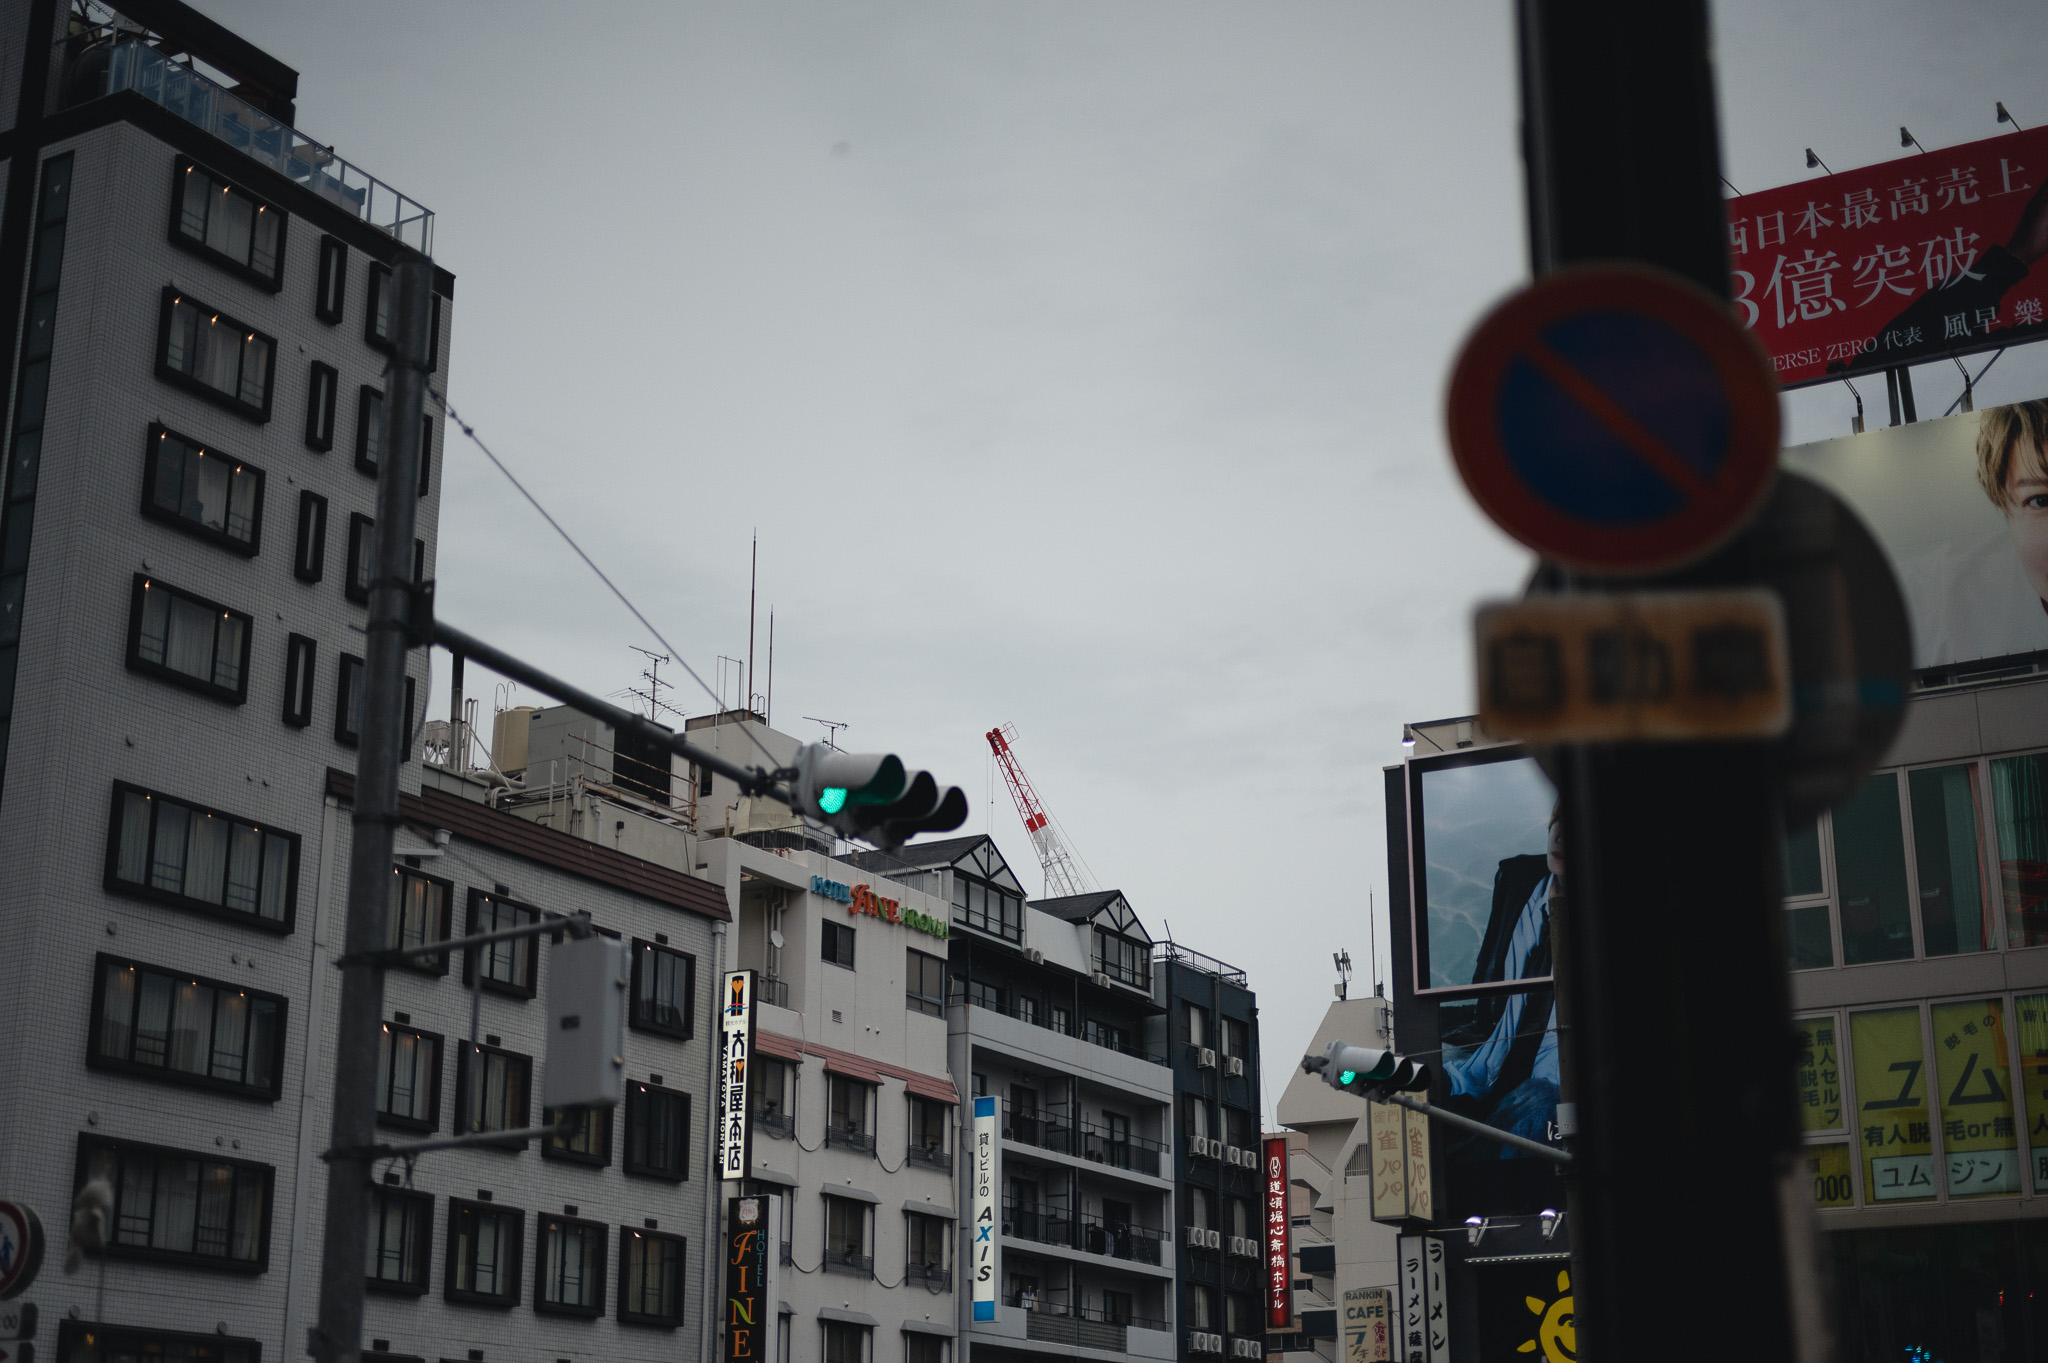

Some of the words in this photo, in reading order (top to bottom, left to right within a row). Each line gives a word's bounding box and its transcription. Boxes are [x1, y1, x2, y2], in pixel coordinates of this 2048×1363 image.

[1826, 336, 1878, 360] ZERO
[1884, 326, 1924, 351] 代表
[1943, 306, 2002, 341] 風早
[811, 875, 852, 904] HOTEL
[849, 884, 900, 924] FINE
[900, 906, 950, 940] AROMA
[720, 1045, 729, 1108] YAMATOYA
[727, 1029, 745, 1171] 大和屋本店
[1816, 1029, 1840, 1125] 無人セルフ
[718, 1116, 726, 1165] HONTEN
[979, 1132, 990, 1198] 貸しビルの
[1377, 1130, 1403, 1201] 雀パパ
[1409, 1126, 1429, 1213] 雀パパ
[756, 1229, 766, 1287] HOTEL
[975, 1205, 994, 1283] AXIS
[729, 1229, 758, 1358] FINE
[1345, 1290, 1383, 1301] RANKIN
[1346, 1305, 1384, 1320] CAFE
[1429, 1243, 1446, 1351] ラーメン
